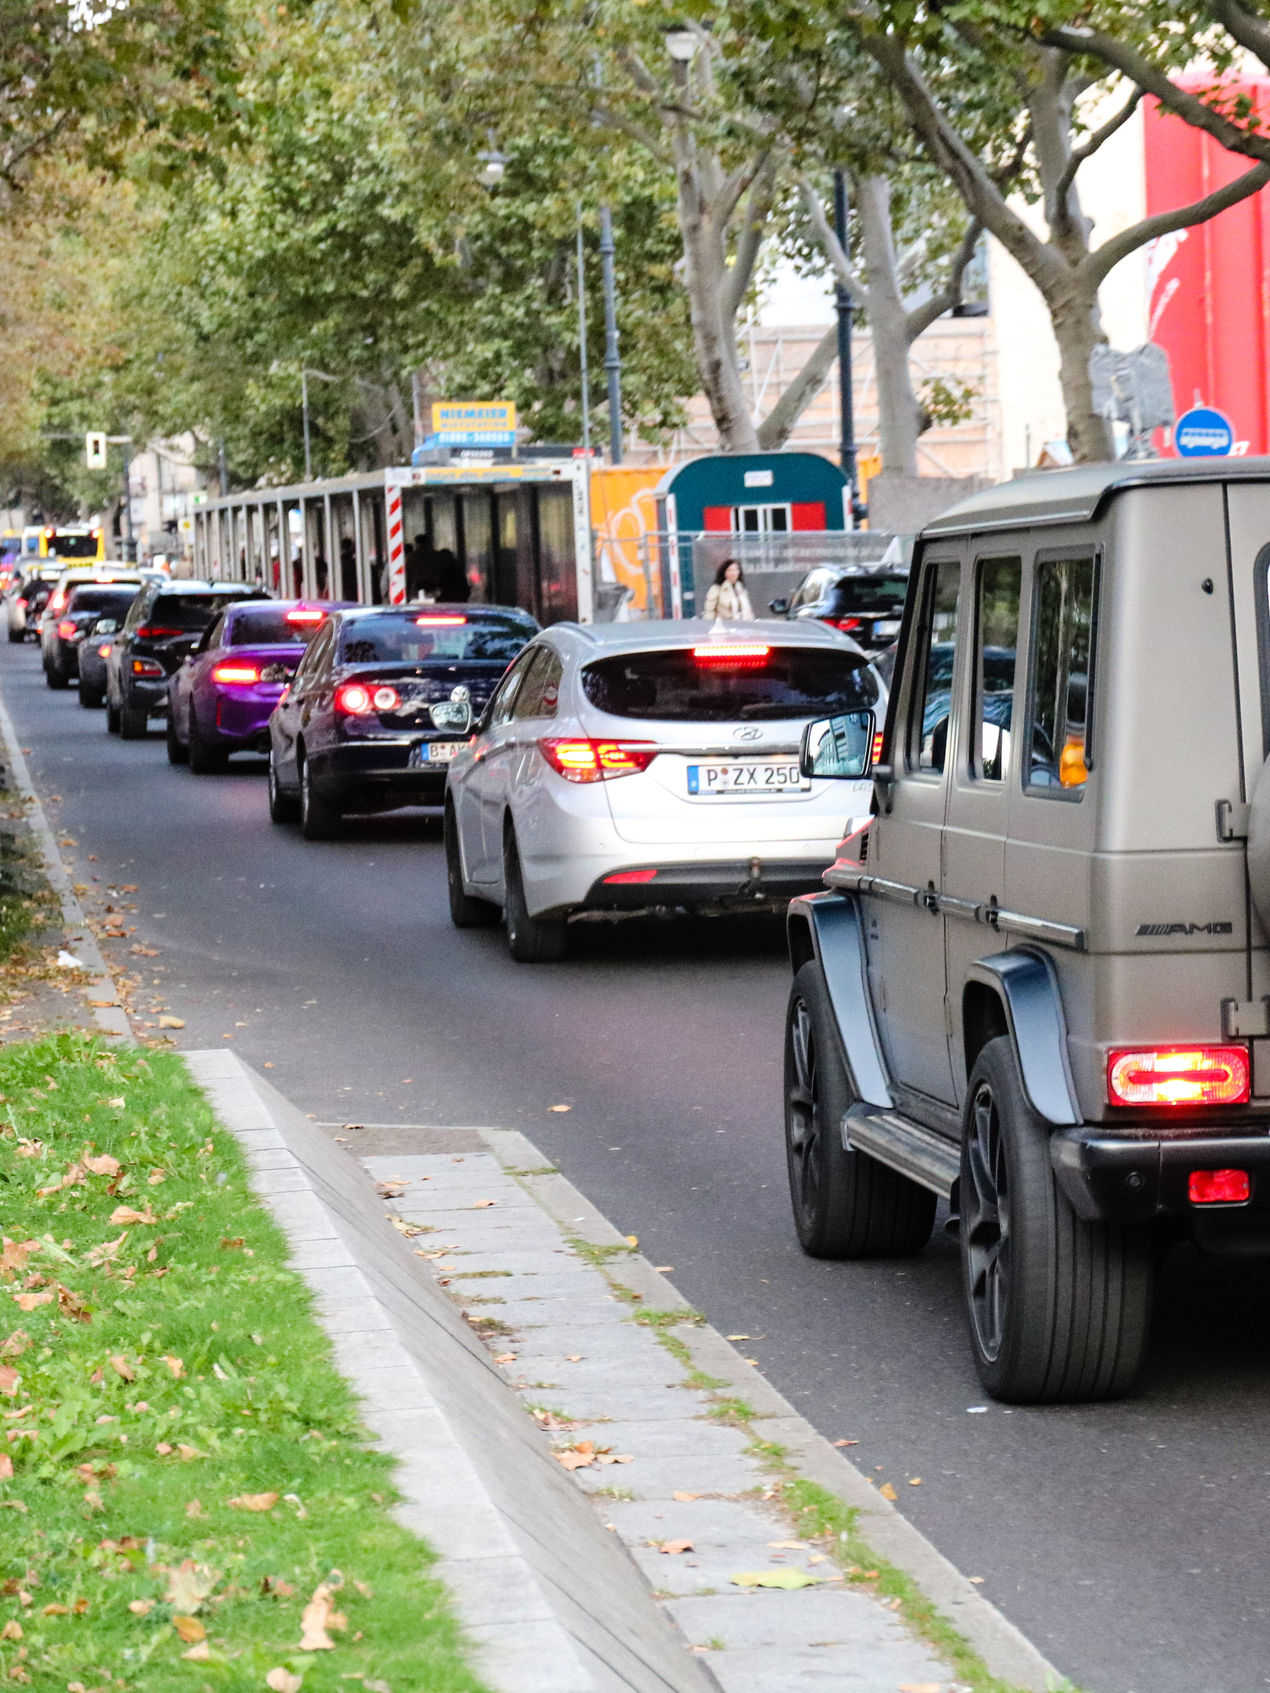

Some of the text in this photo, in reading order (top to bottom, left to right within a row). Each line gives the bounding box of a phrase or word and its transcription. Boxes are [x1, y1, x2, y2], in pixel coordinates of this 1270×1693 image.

[440, 408, 508, 419] NIEMEIER
[429, 744, 440, 758] B
[706, 766, 801, 787] P ZX 250
[1165, 922, 1232, 935] AMG
